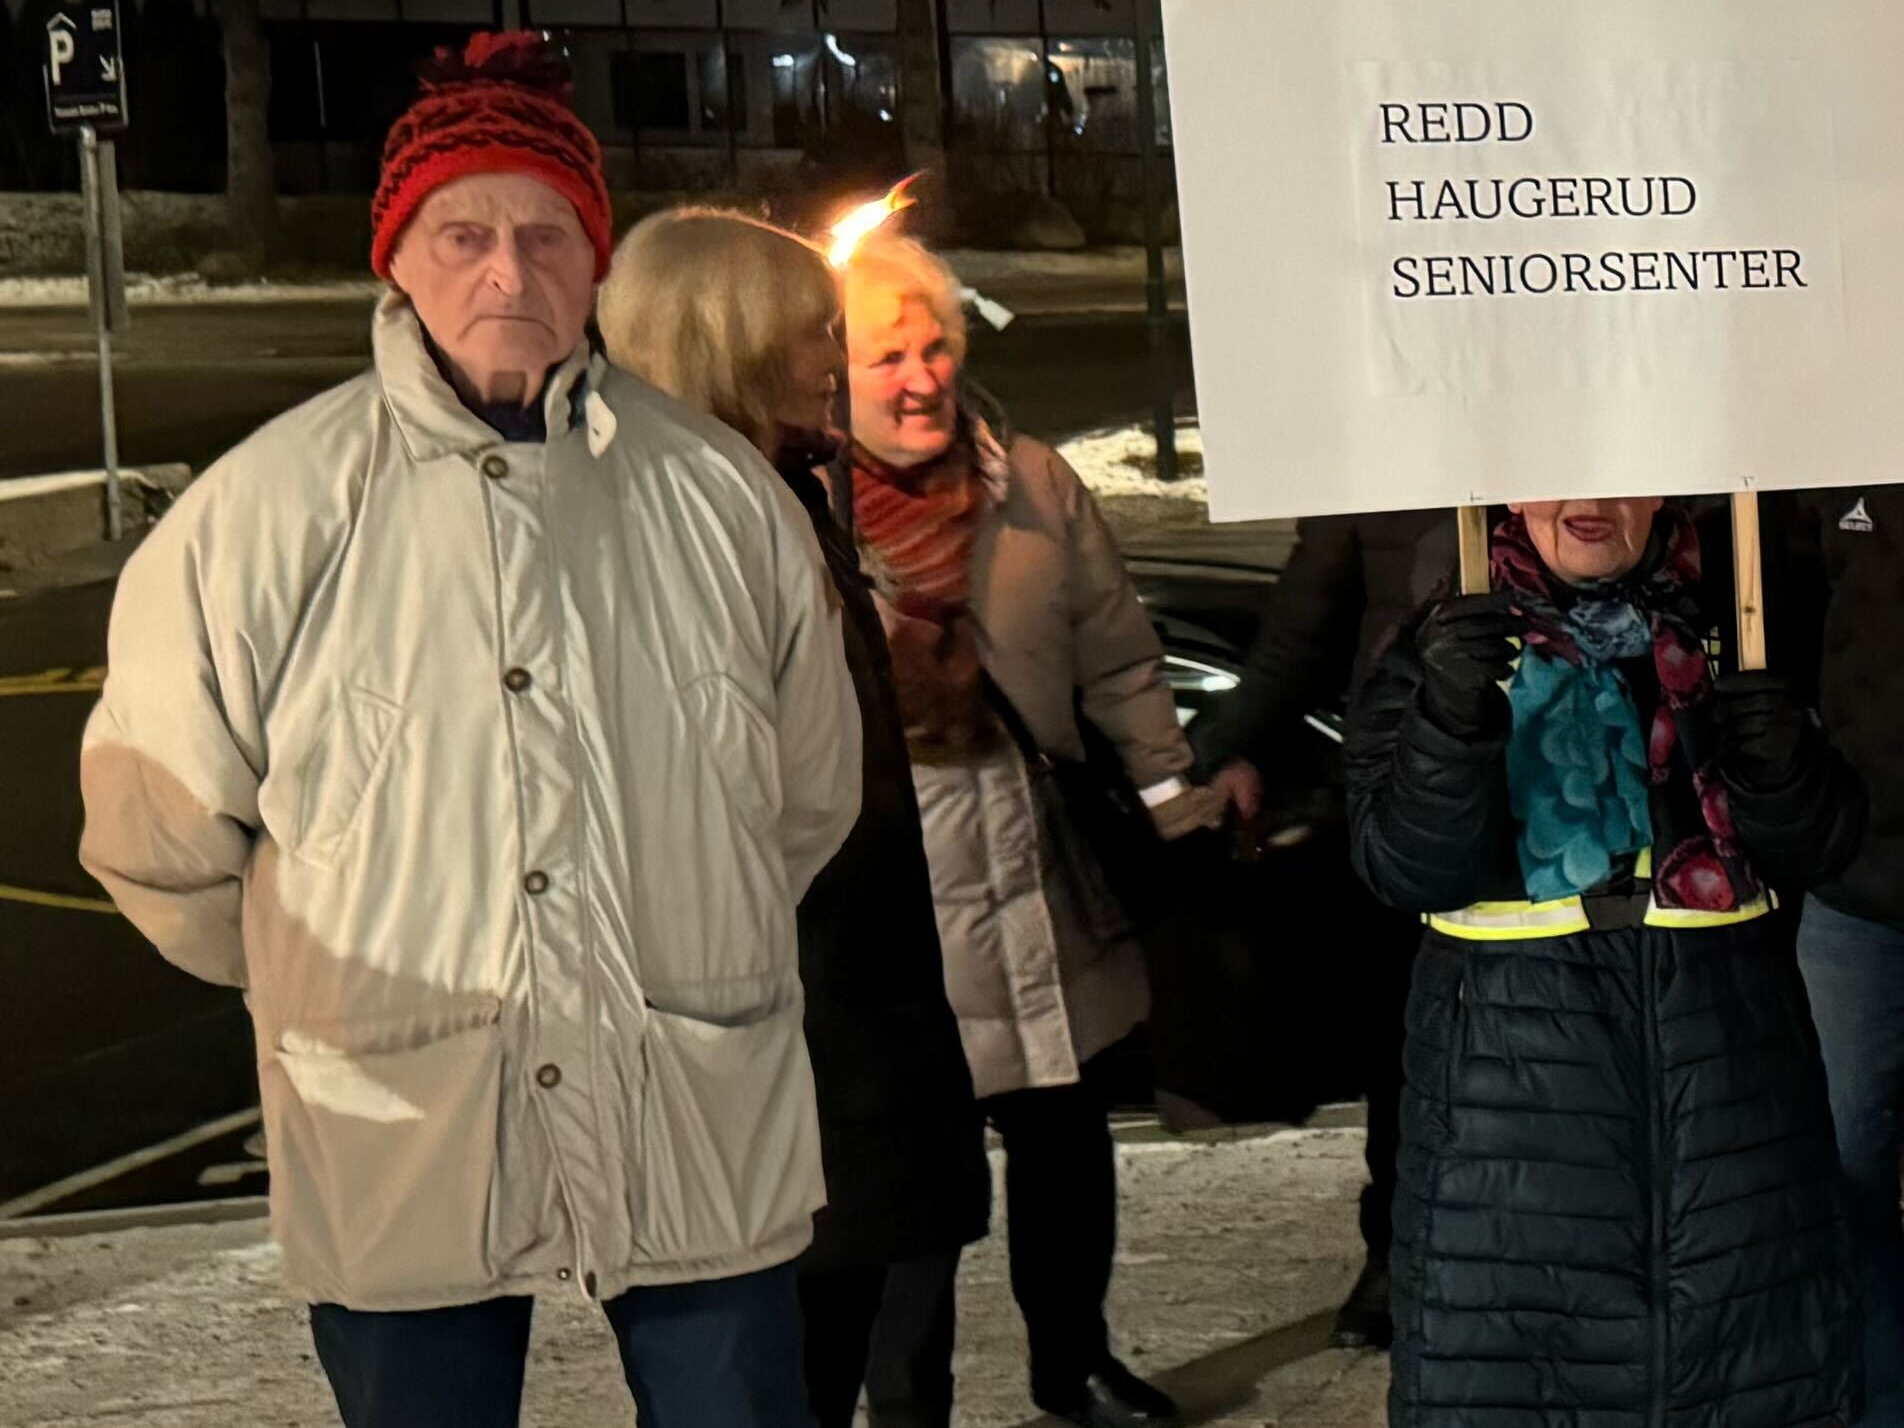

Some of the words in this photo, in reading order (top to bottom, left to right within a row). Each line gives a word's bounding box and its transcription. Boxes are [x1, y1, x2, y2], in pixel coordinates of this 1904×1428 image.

[50, 30, 75, 86] P
[1379, 102, 1533, 143] REDD
[1385, 176, 1697, 221] HAUGERUD
[1392, 249, 1808, 298] SENIORSENTER
